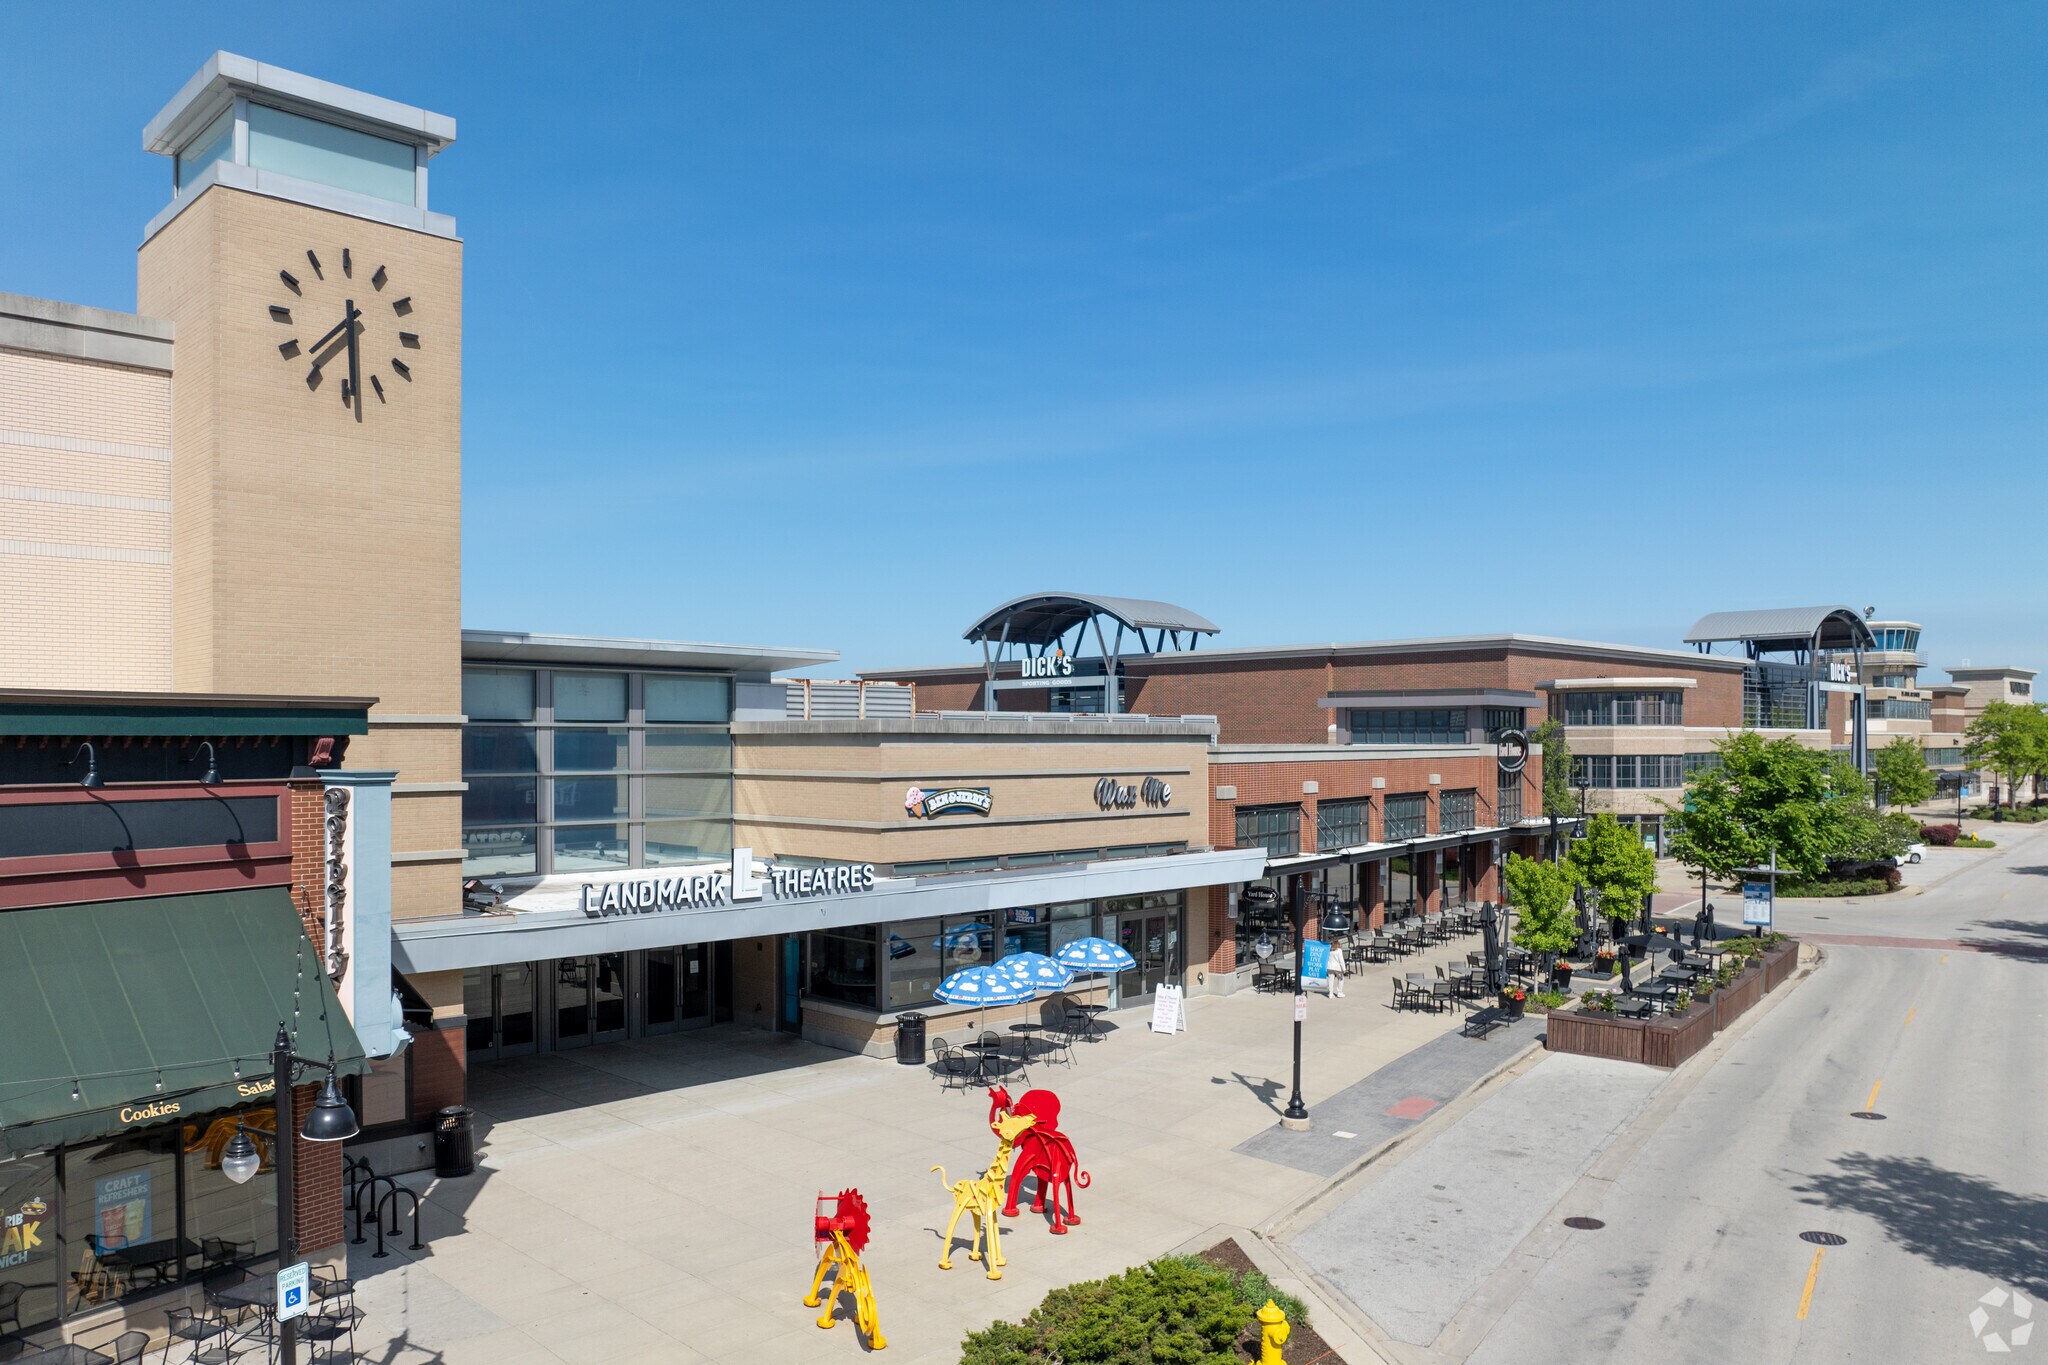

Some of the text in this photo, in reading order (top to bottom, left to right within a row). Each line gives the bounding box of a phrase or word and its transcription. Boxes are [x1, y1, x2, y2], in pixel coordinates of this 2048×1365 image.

[1022, 655, 1072, 677] DICK'S
[1094, 777, 1137, 806] Wax
[584, 847, 875, 915] LANDMARK L THEATRES
[120, 1101, 181, 1123] Cookies
[104, 1174, 142, 1193] CRAFT
[98, 1184, 148, 1204] REFRESHERS
[5, 1213, 24, 1228] RIB
[280, 1268, 306, 1281] RESERVED
[282, 1276, 305, 1289] PARKING
